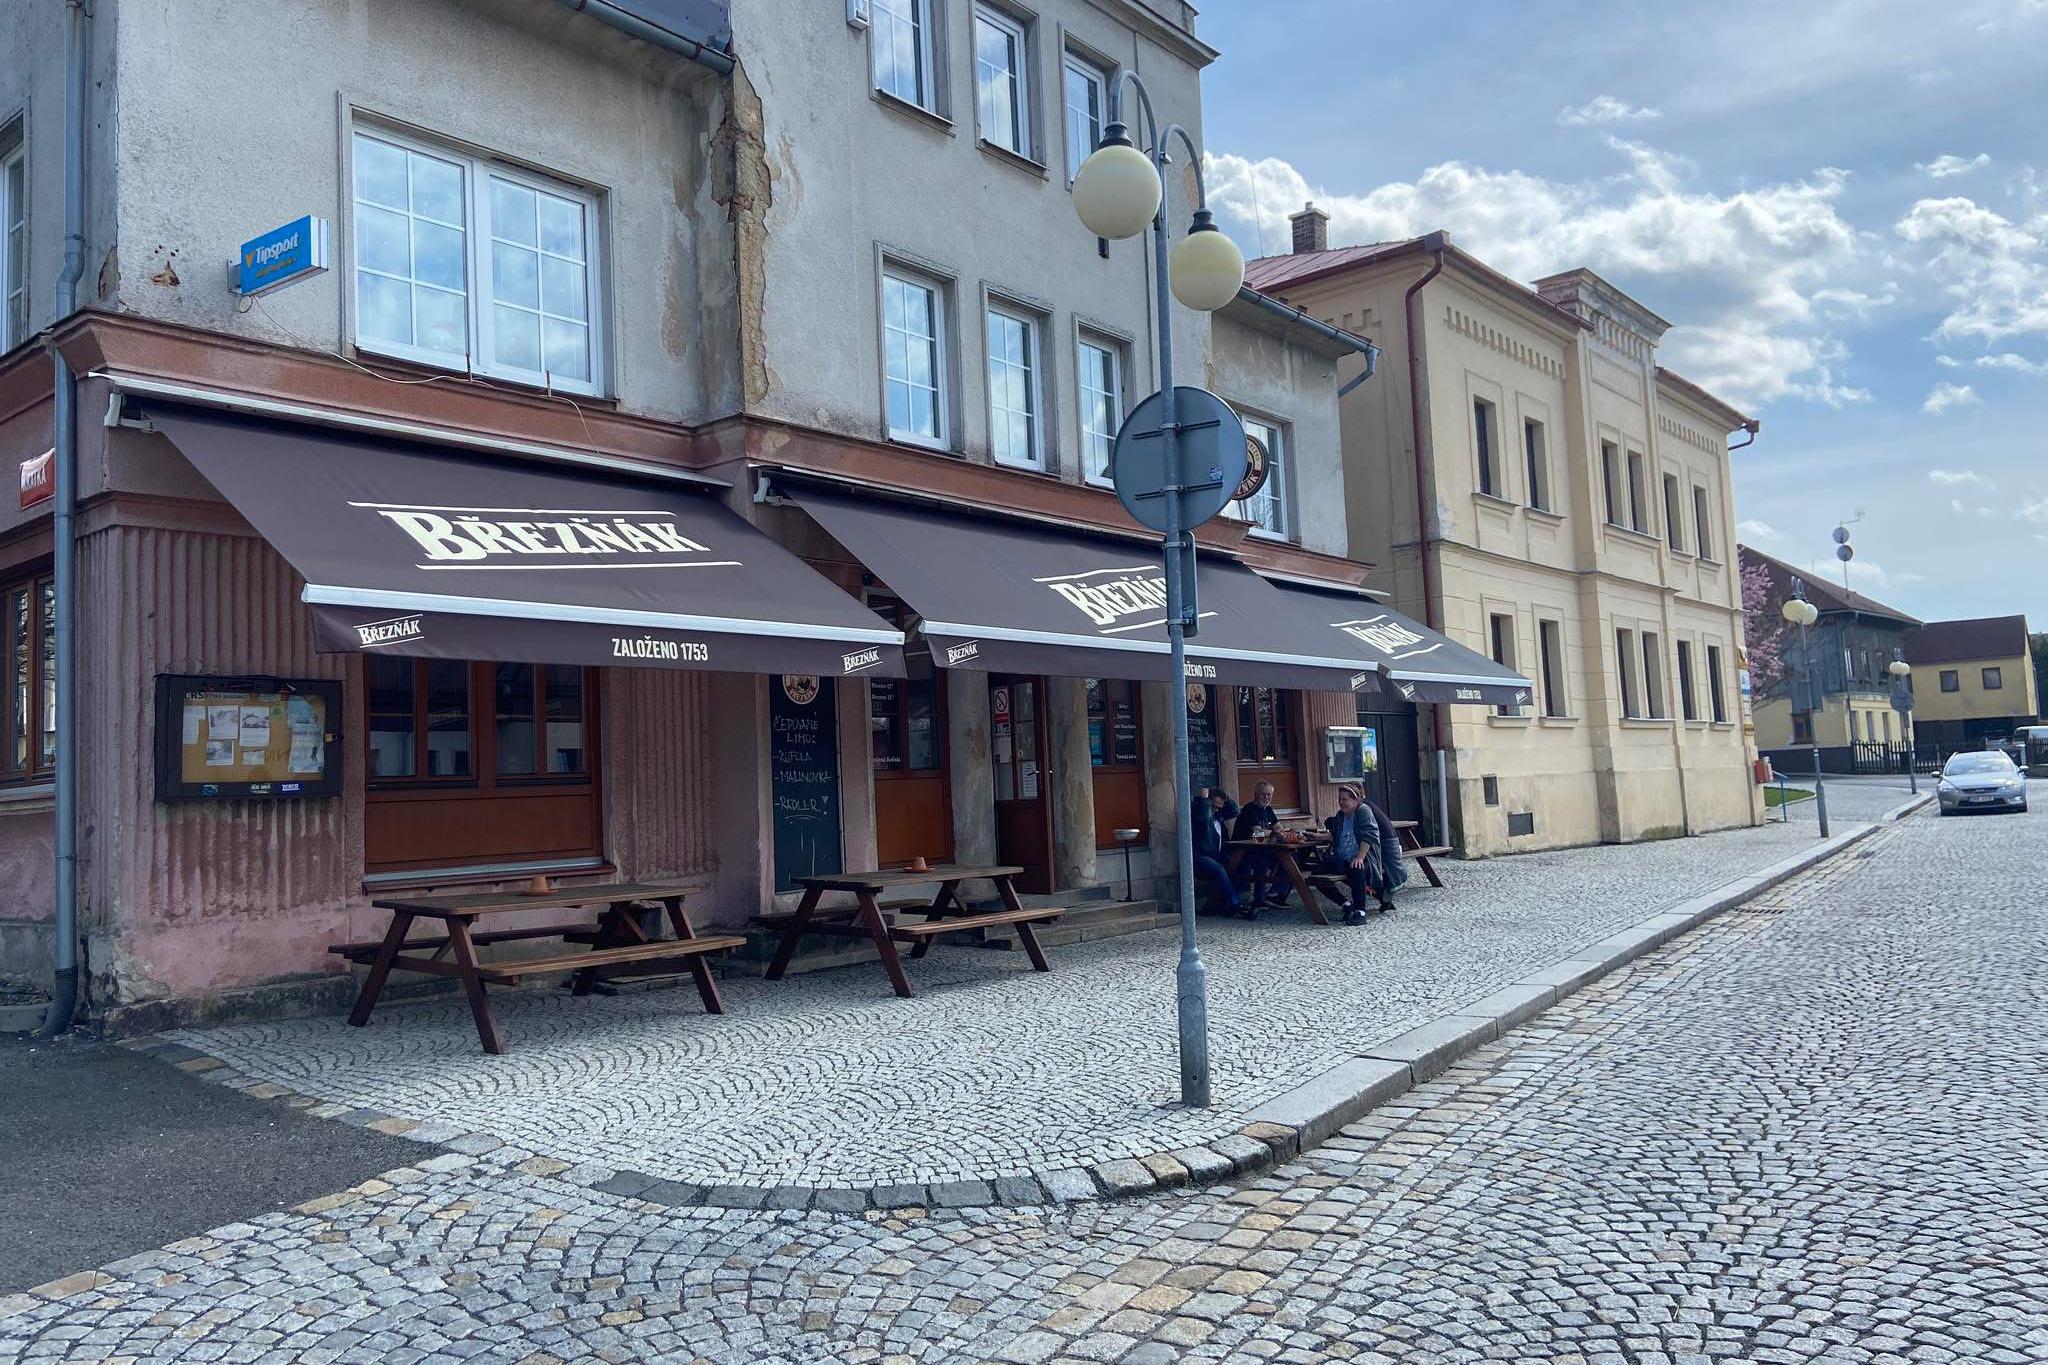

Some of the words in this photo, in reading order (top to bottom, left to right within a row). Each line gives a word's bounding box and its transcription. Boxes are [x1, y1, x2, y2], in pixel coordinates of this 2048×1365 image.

[256, 231, 299, 265] Tipsport
[377, 510, 712, 561] BŘEZŇÁK
[358, 619, 421, 646] BŘEZŇÁK
[611, 635, 678, 660] ZALOŽENO
[680, 642, 709, 662] 1753
[843, 650, 880, 672] BŘEZŇÁK
[948, 643, 978, 664] BŘEZŇÁK
[1203, 664, 1217, 678] 1753
